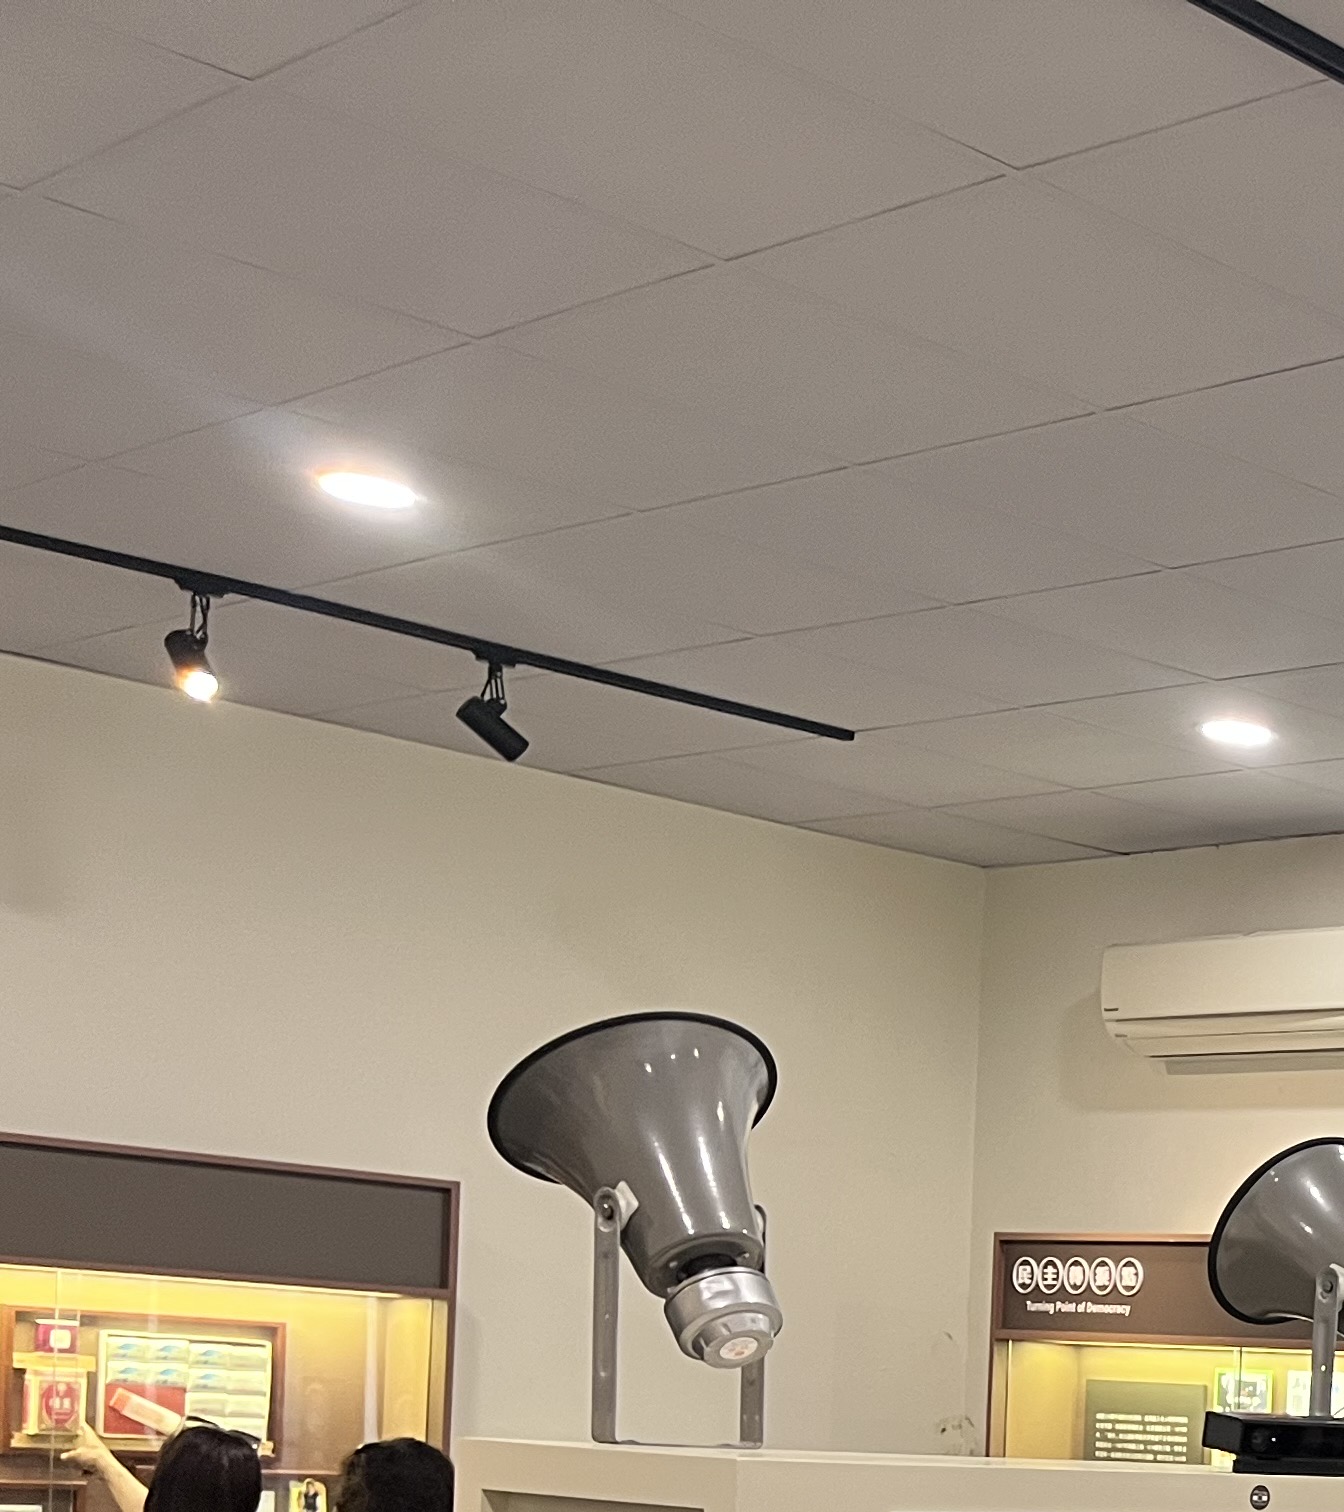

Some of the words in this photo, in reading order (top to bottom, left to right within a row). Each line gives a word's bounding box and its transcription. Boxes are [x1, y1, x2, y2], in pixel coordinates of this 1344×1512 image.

[1026, 1300, 1055, 1315] Turning
[1055, 1301, 1077, 1313] Point
[1077, 1301, 1086, 1313] of
[1086, 1301, 1131, 1317] Democracy
